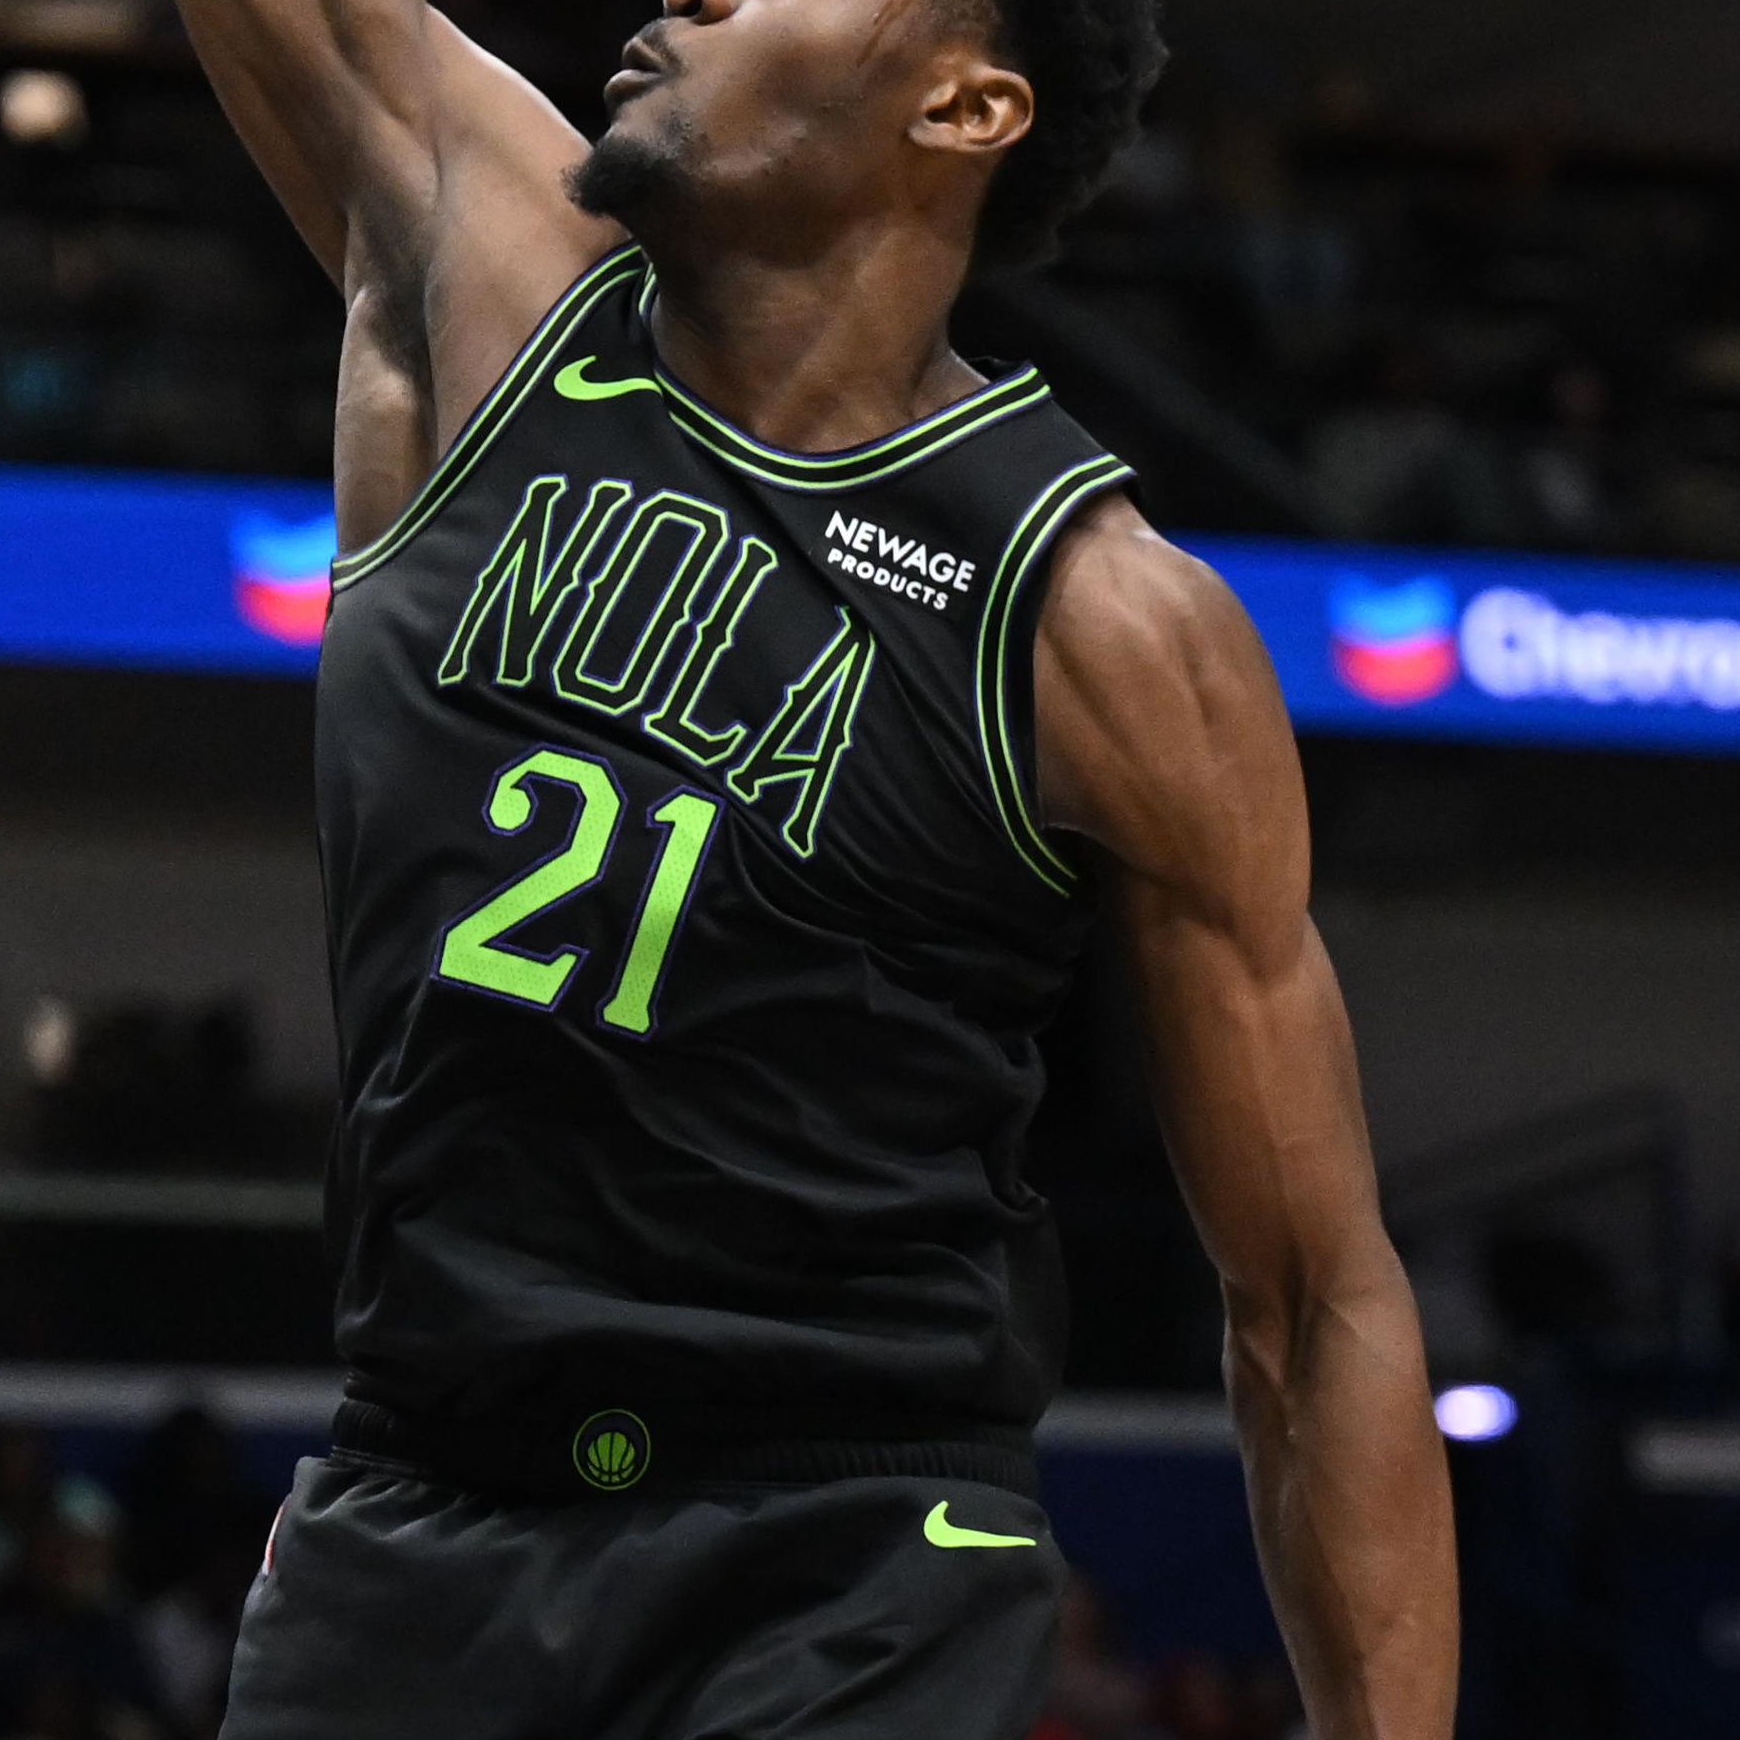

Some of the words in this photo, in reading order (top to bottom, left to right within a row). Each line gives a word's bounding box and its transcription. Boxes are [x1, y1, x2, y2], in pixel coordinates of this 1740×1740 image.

[824, 509, 977, 593] NEWAGE
[826, 547, 949, 611] PRODUCTS
[436, 473, 877, 860] NOLA
[430, 749, 727, 1042] 21
